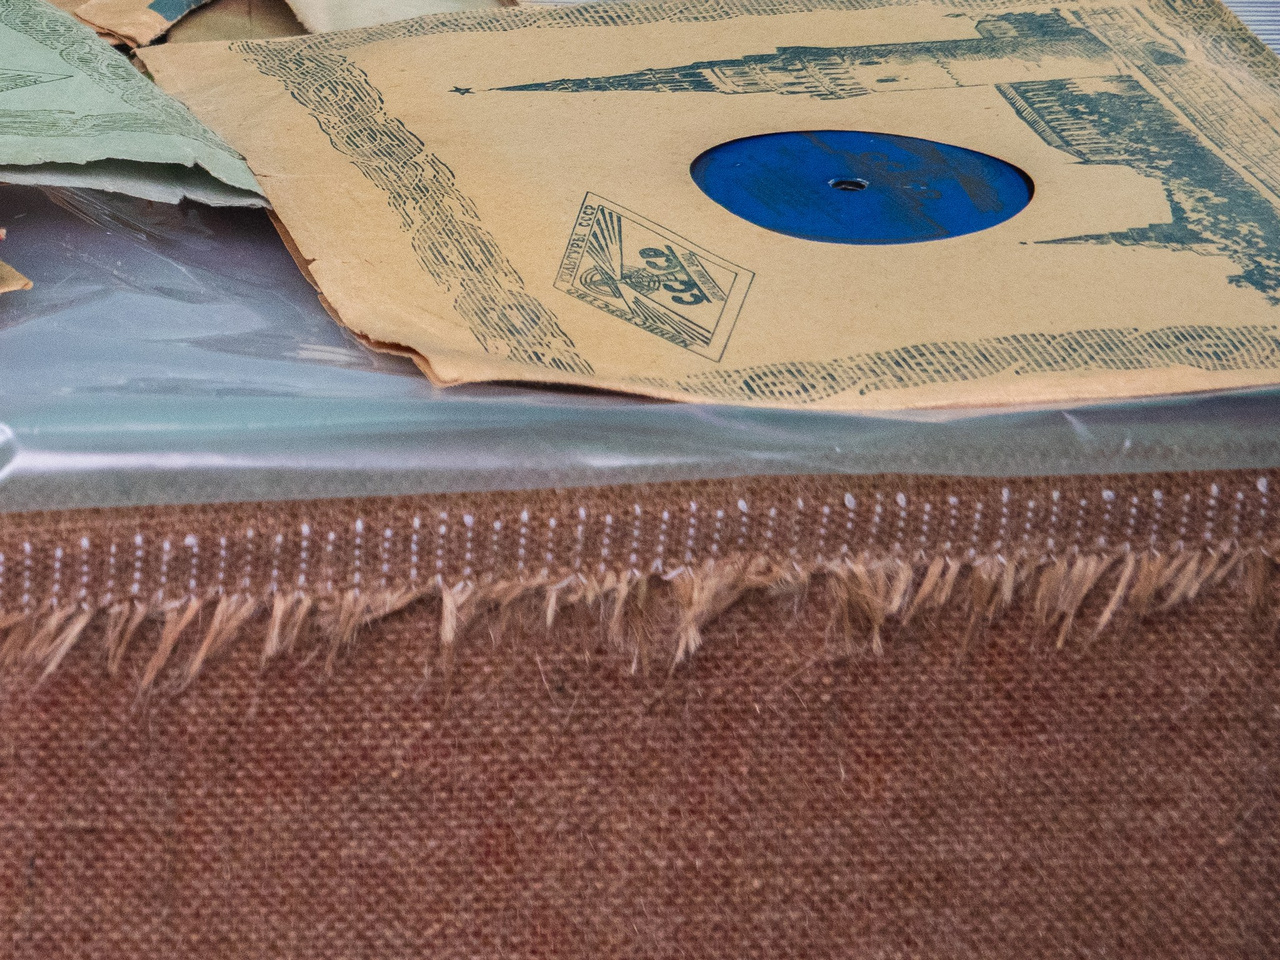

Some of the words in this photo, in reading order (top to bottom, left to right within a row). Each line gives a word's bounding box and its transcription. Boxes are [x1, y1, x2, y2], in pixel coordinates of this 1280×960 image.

[578, 204, 597, 228] СССР
[560, 232, 587, 284] КУЛЬТУРЫ
[638, 247, 705, 306] СССР
[565, 287, 695, 348] МИНИСТЕРСТВО
